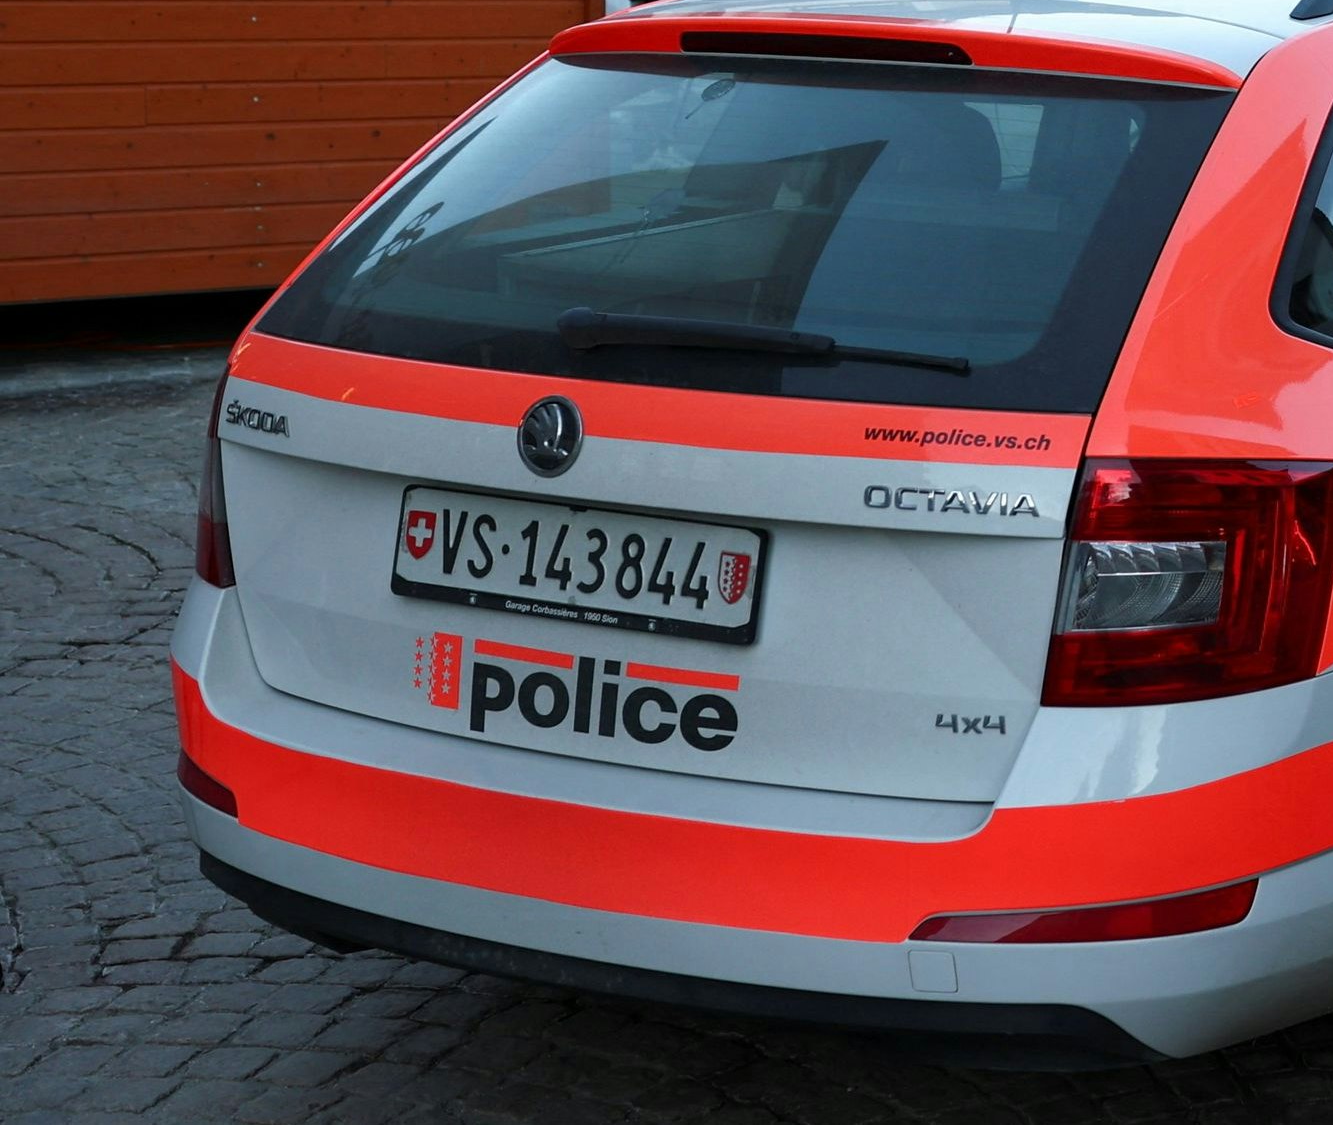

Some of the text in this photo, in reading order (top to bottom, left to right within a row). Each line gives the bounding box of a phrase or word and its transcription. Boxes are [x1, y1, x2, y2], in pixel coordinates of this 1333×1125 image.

[226, 399, 290, 438] ŠKODA
[864, 427, 1051, 451] www.police.vs.ch
[864, 485, 1040, 518] OCTAVIA
[505, 600, 531, 612] Garage
[532, 604, 578, 618] Corbassières
[601, 614, 618, 624] Sion
[469, 655, 739, 752] police
[934, 713, 1007, 736] 4x4
